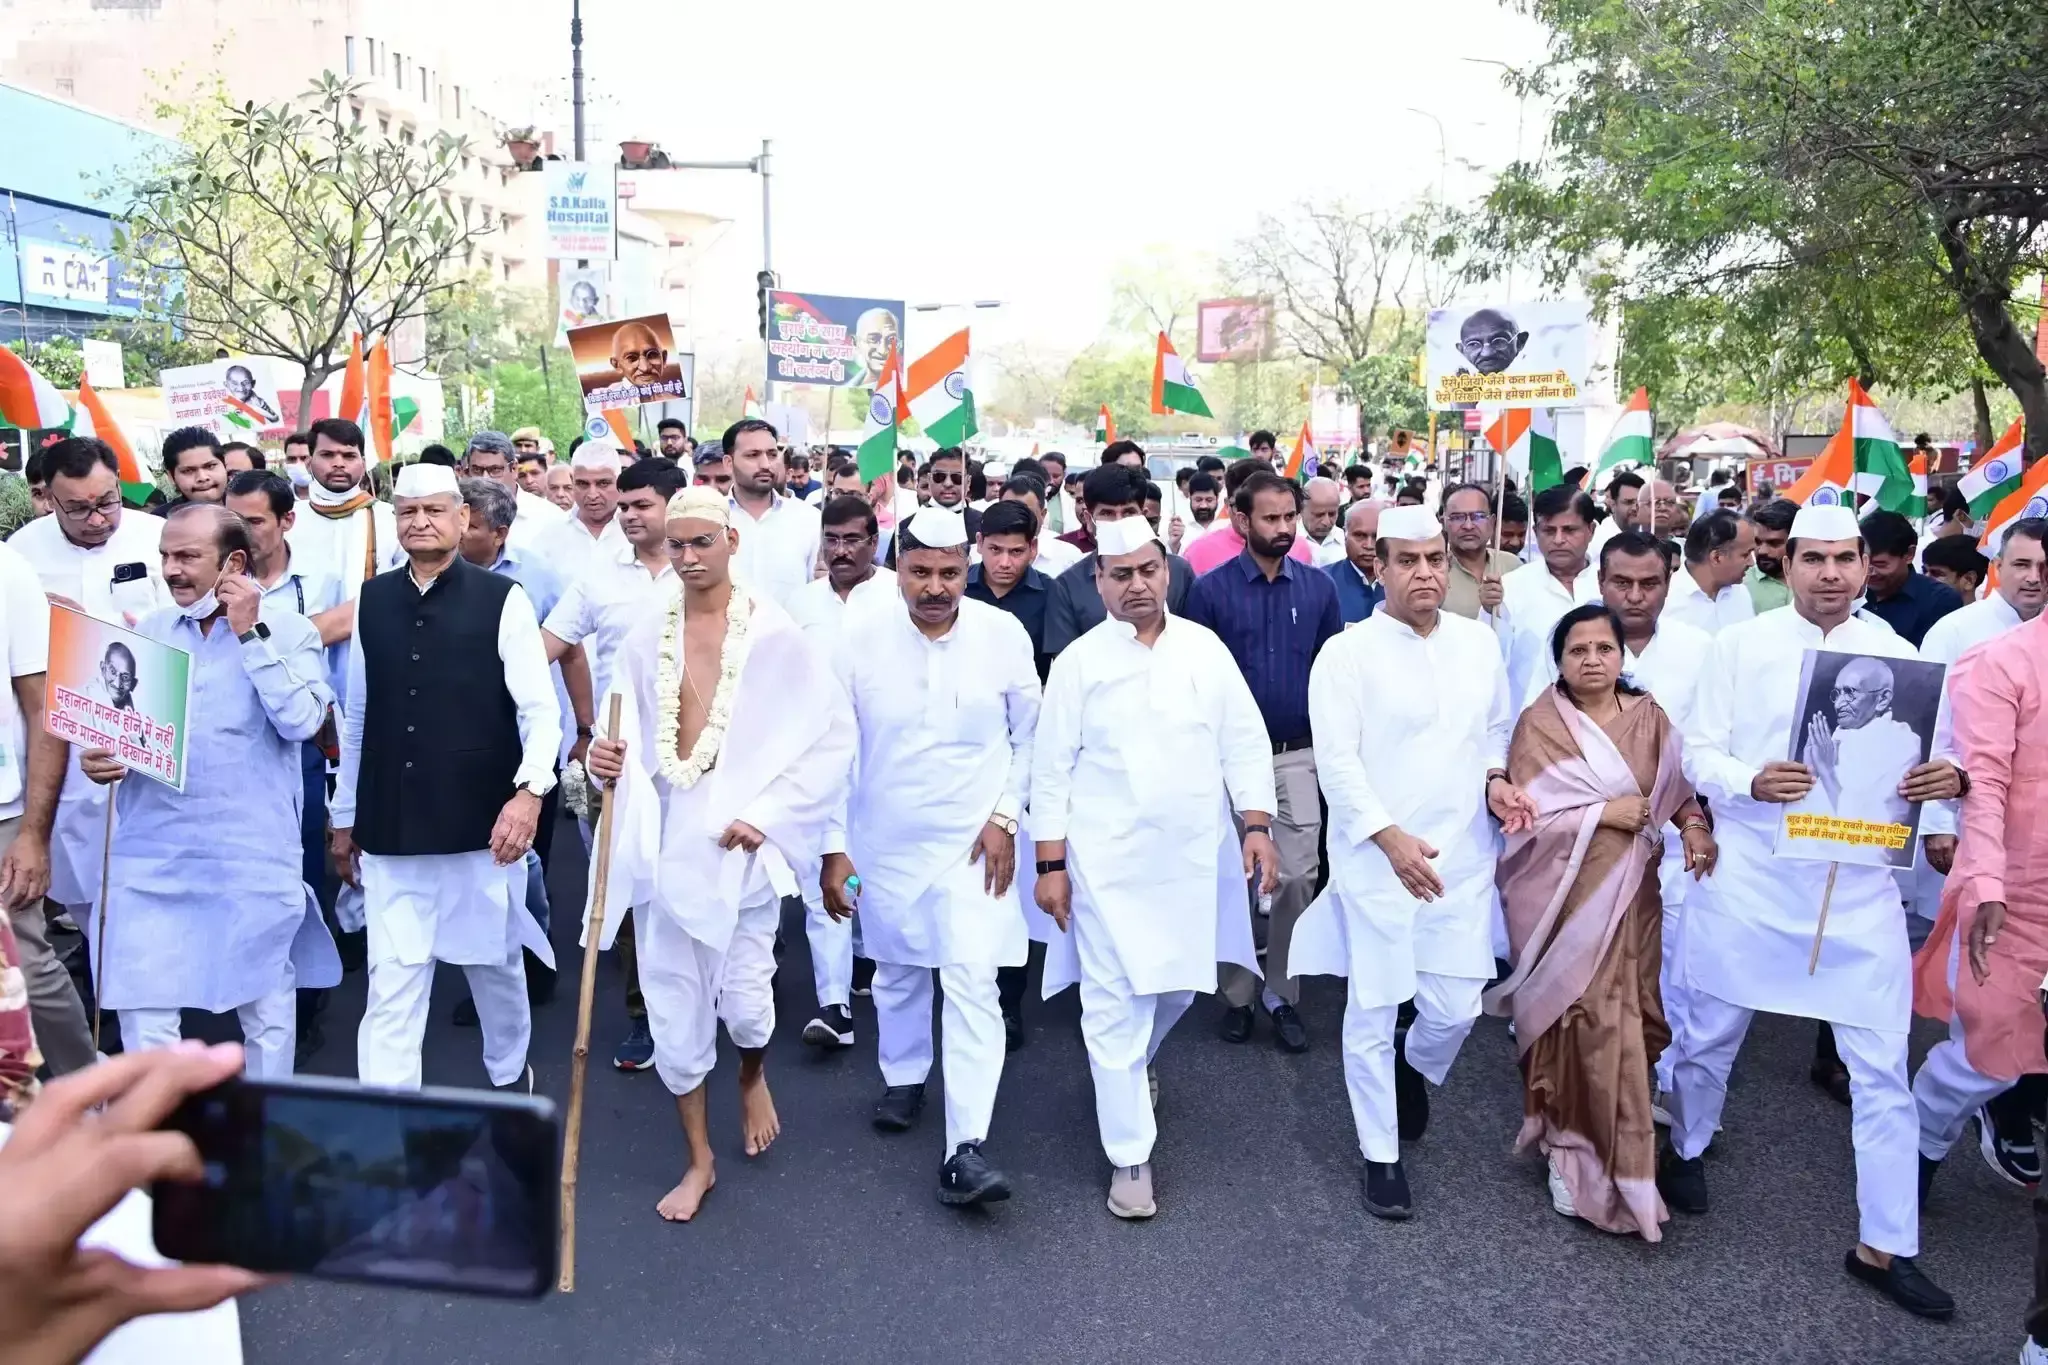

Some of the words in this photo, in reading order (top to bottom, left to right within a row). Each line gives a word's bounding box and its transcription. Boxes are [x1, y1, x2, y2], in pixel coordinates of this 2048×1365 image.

[547, 210, 609, 224] Hospital
[779, 317, 806, 339] बुराई
[807, 318, 818, 336] के
[819, 323, 846, 340] साथ
[770, 339, 810, 357] सहयोग
[811, 344, 822, 358] न
[823, 345, 853, 359] करना
[779, 357, 794, 376] भी
[795, 359, 830, 379] कर्तव्य
[1442, 375, 1457, 389] ऐसे
[1460, 373, 1483, 387] जियो
[1487, 372, 1504, 386] जैसे
[1508, 375, 1526, 384] कल
[1529, 374, 1553, 384] मरना
[169, 391, 190, 405] जीवन
[191, 392, 201, 401] का
[1436, 389, 1451, 404] ऐसे
[1484, 386, 1501, 400] जैसे
[1505, 386, 1532, 400] हमेशा
[1535, 385, 1559, 398] जीना
[176, 408, 202, 420] मानवता
[203, 403, 213, 416] की
[57, 687, 92, 713] महानता
[95, 702, 120, 726] मानव
[123, 708, 143, 733] होने
[144, 715, 154, 739] में
[155, 724, 174, 749] नही
[51, 710, 78, 735] बल्कि
[80, 724, 115, 754] मानवता
[119, 735, 153, 767] दिखाने
[155, 749, 165, 772] में
[1786, 815, 1801, 826] खुद
[1802, 814, 1812, 825] को
[1814, 815, 1829, 826] पाने
[1831, 819, 1841, 828] का
[1842, 819, 1863, 831] सबसे
[1886, 823, 1909, 836] तरीका
[1809, 827, 1820, 838] की
[1820, 828, 1837, 841] सेवा
[1846, 834, 1861, 845] खुद
[1863, 832, 1873, 844] को
[1875, 834, 1886, 846] खो
[1888, 835, 1903, 848] देना
